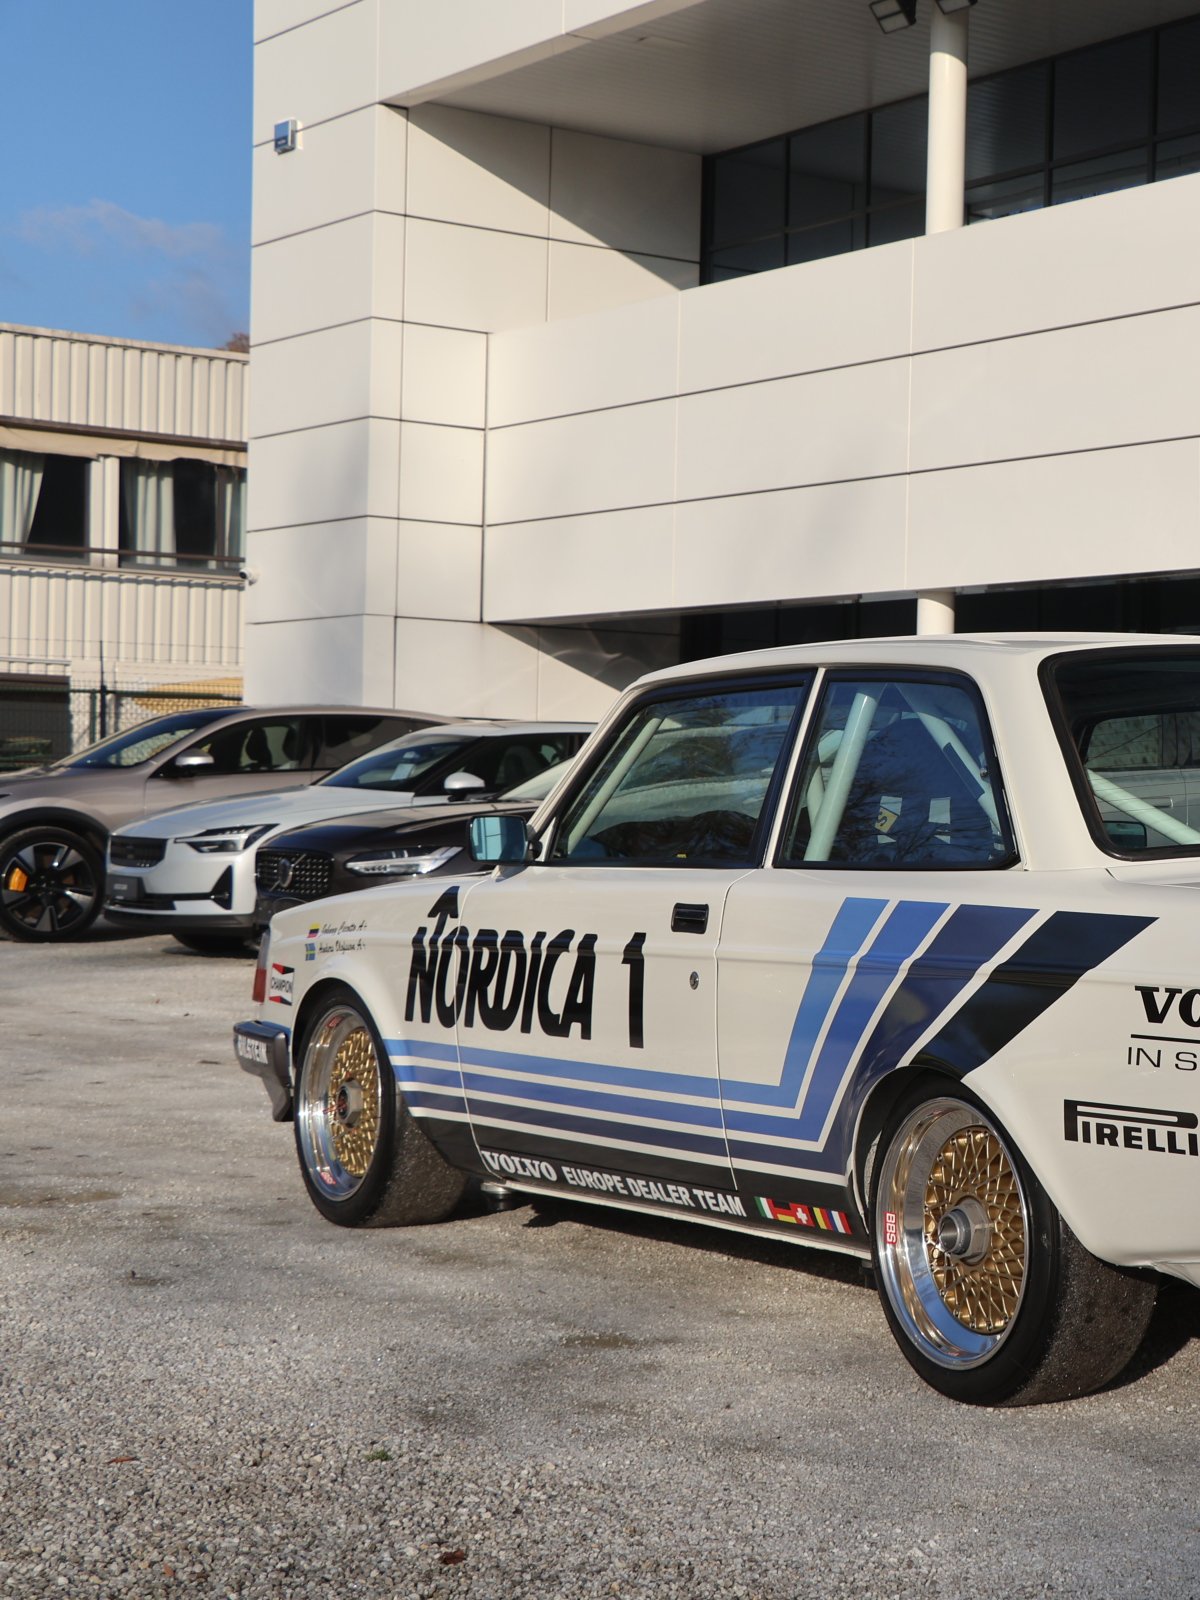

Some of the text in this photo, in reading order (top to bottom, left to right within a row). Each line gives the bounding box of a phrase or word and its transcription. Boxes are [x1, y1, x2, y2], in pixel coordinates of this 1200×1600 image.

[405, 886, 646, 1049] NORDICA 1
[1128, 1047, 1162, 1068] IN
[1063, 1099, 1199, 1156] PIRELLI
[481, 1150, 748, 1218] VOLVO EUROPE DEALER TEAM
[886, 1212, 897, 1243] BBS
